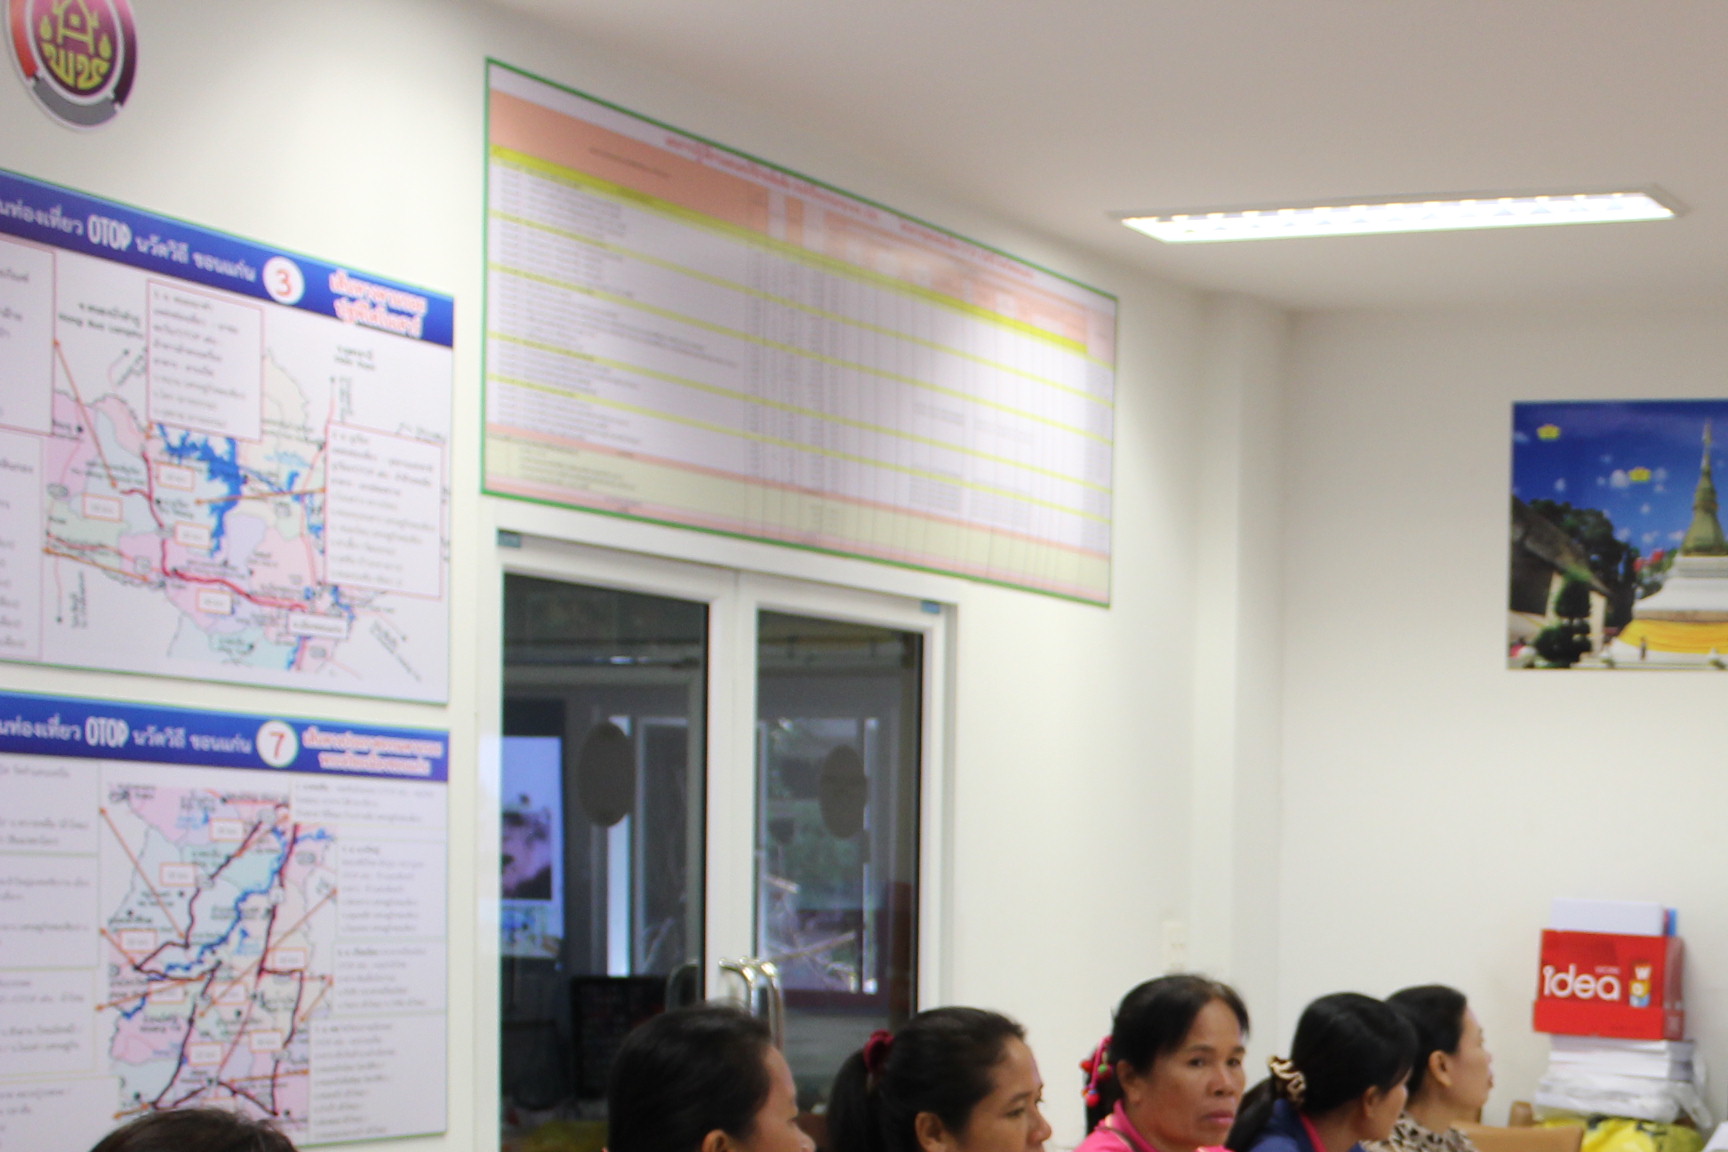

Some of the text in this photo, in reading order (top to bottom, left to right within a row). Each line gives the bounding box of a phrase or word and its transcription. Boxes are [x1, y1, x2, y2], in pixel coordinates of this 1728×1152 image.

[87, 214, 133, 251] OTOP
[274, 269, 292, 297] 3
[85, 716, 130, 748] OTOP
[269, 731, 286, 759] 7
[1543, 963, 1622, 1001] idea
